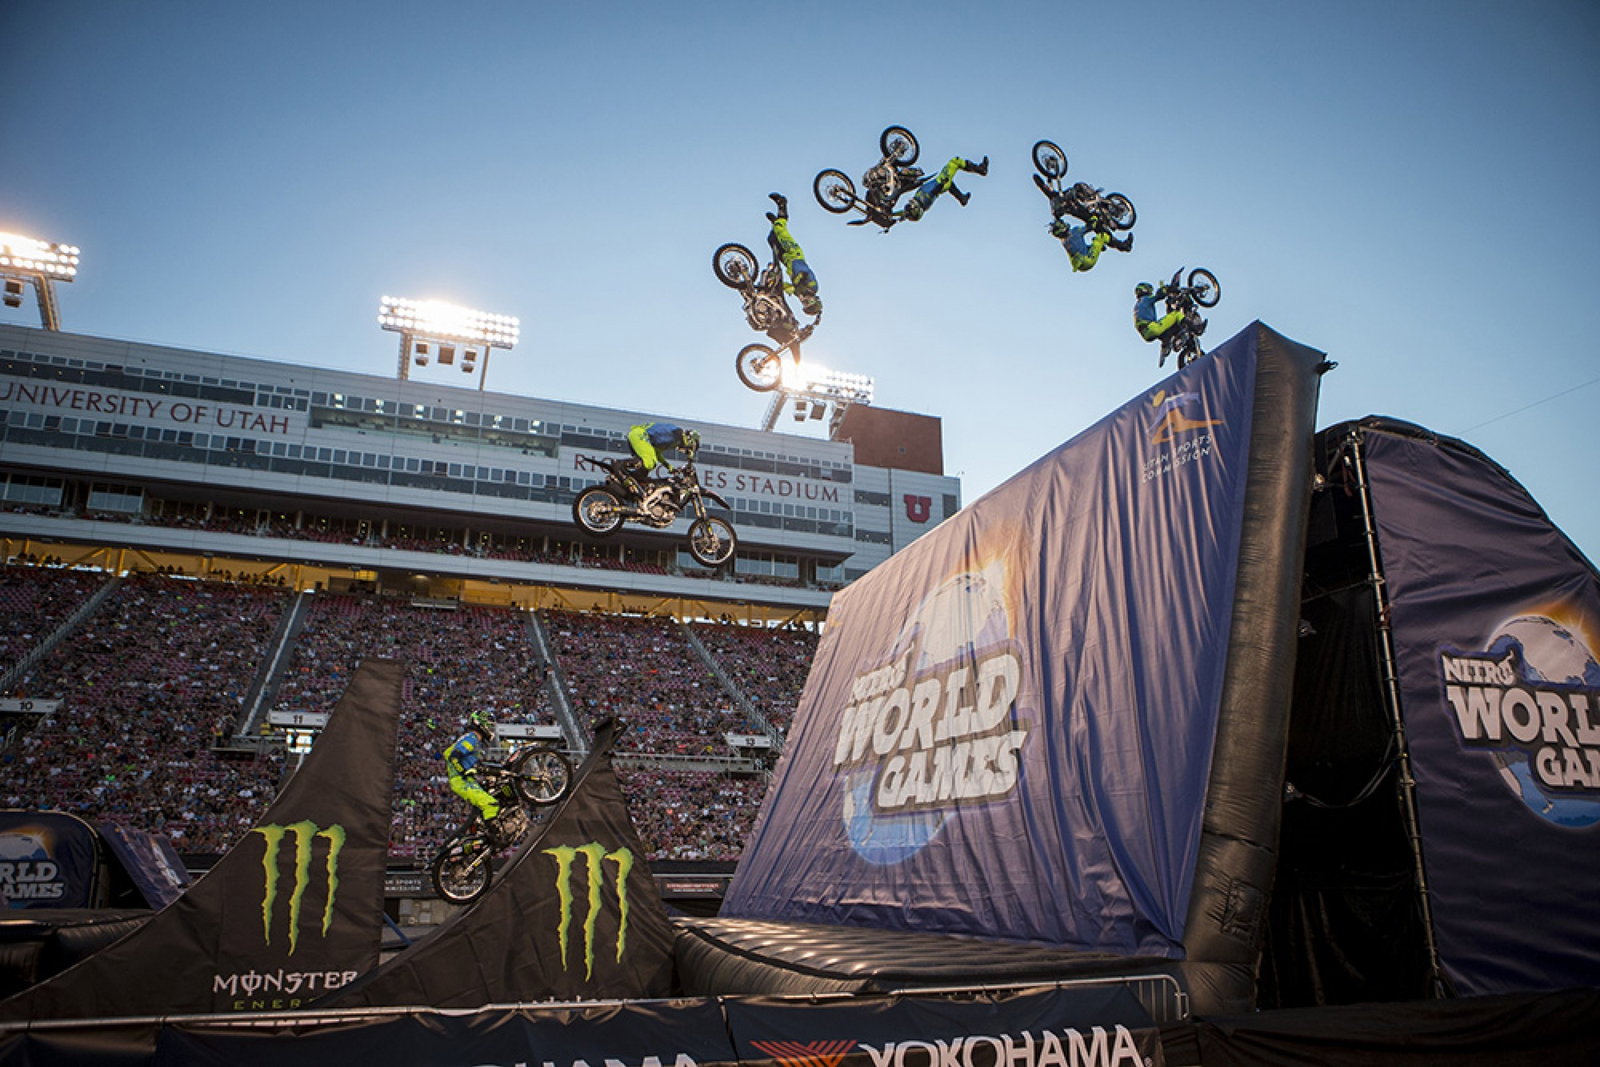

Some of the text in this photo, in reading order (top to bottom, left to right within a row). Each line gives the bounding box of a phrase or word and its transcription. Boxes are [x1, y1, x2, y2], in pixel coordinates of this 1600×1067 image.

[0, 382, 289, 434] UNIVERSITY OF UTAH
[735, 474, 839, 503] STADIUM
[1441, 650, 1514, 686] NITRO
[19, 700, 34, 711] 10
[293, 714, 304, 724] 11
[833, 653, 1021, 766] WORLD
[1447, 684, 1600, 748] WORL
[525, 727, 537, 737] 12
[877, 730, 1028, 808] GAMES
[212, 968, 358, 997] MONSTER
[233, 998, 317, 1011] ENER
